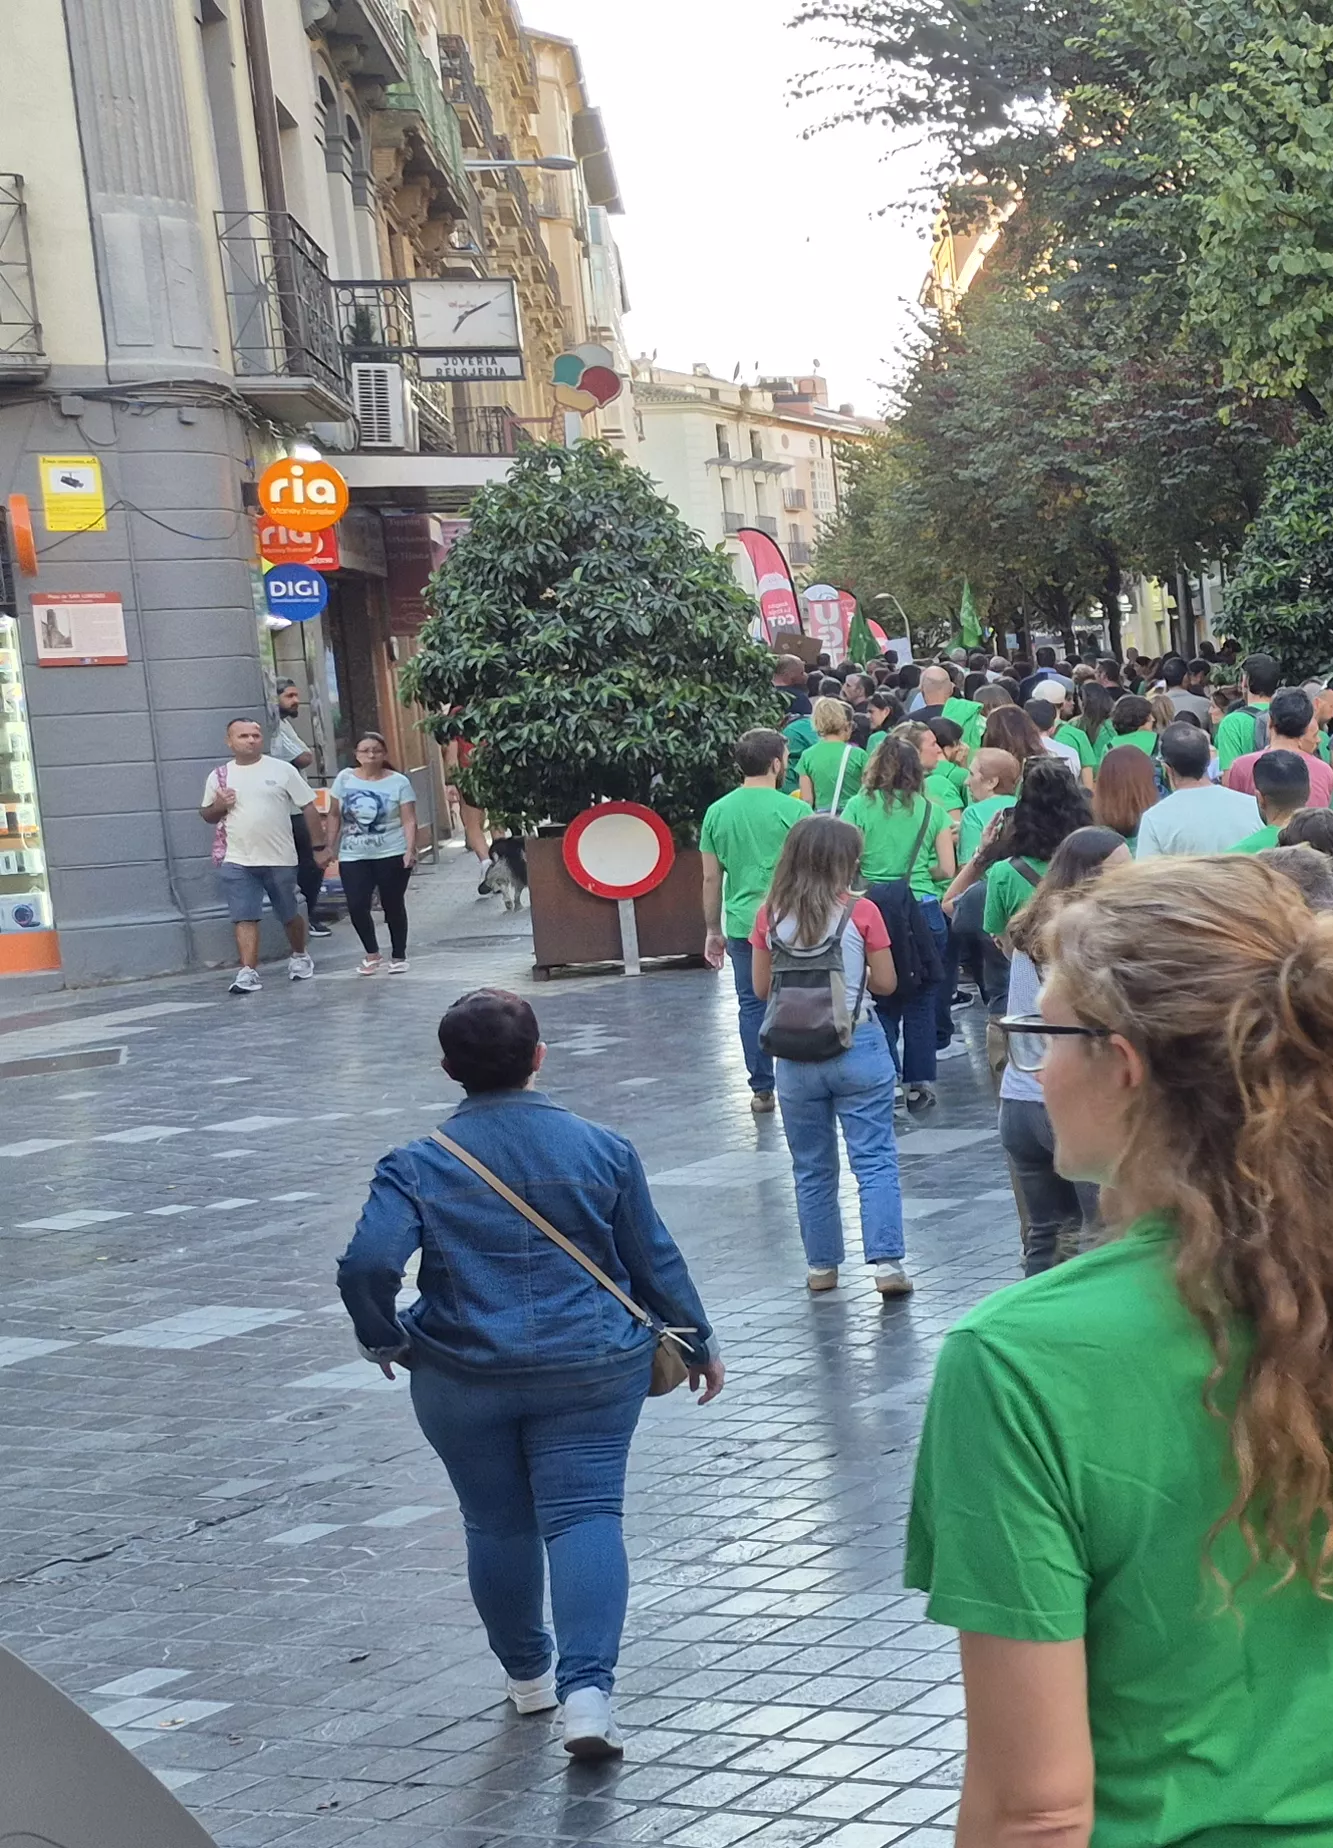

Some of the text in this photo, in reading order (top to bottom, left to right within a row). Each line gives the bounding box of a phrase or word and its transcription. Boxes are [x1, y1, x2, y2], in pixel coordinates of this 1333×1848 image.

[436, 367, 508, 376] RELOJERIA
[270, 465, 336, 504] ria
[269, 580, 320, 597] DIGI
